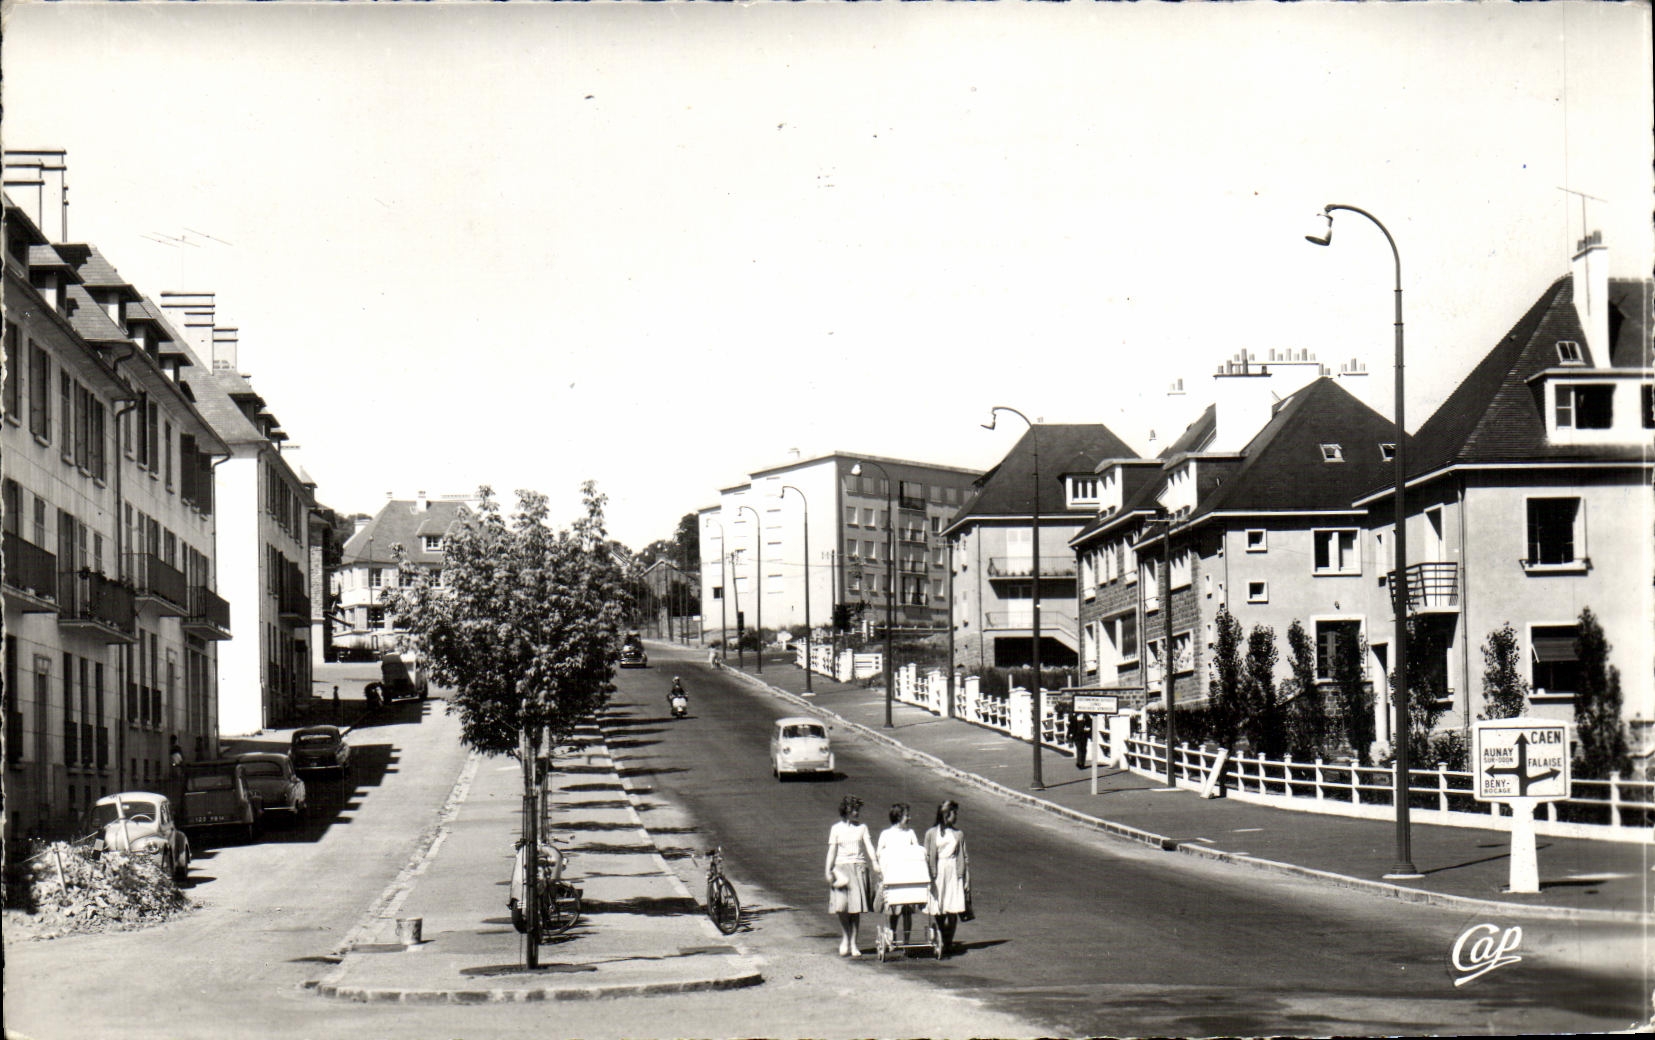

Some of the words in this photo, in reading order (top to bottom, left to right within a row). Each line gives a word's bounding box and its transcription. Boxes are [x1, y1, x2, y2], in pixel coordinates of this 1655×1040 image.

[1531, 731, 1561, 744] CAEN
[1484, 748, 1513, 757] AUNAY
[1528, 758, 1562, 767] FALAISE
